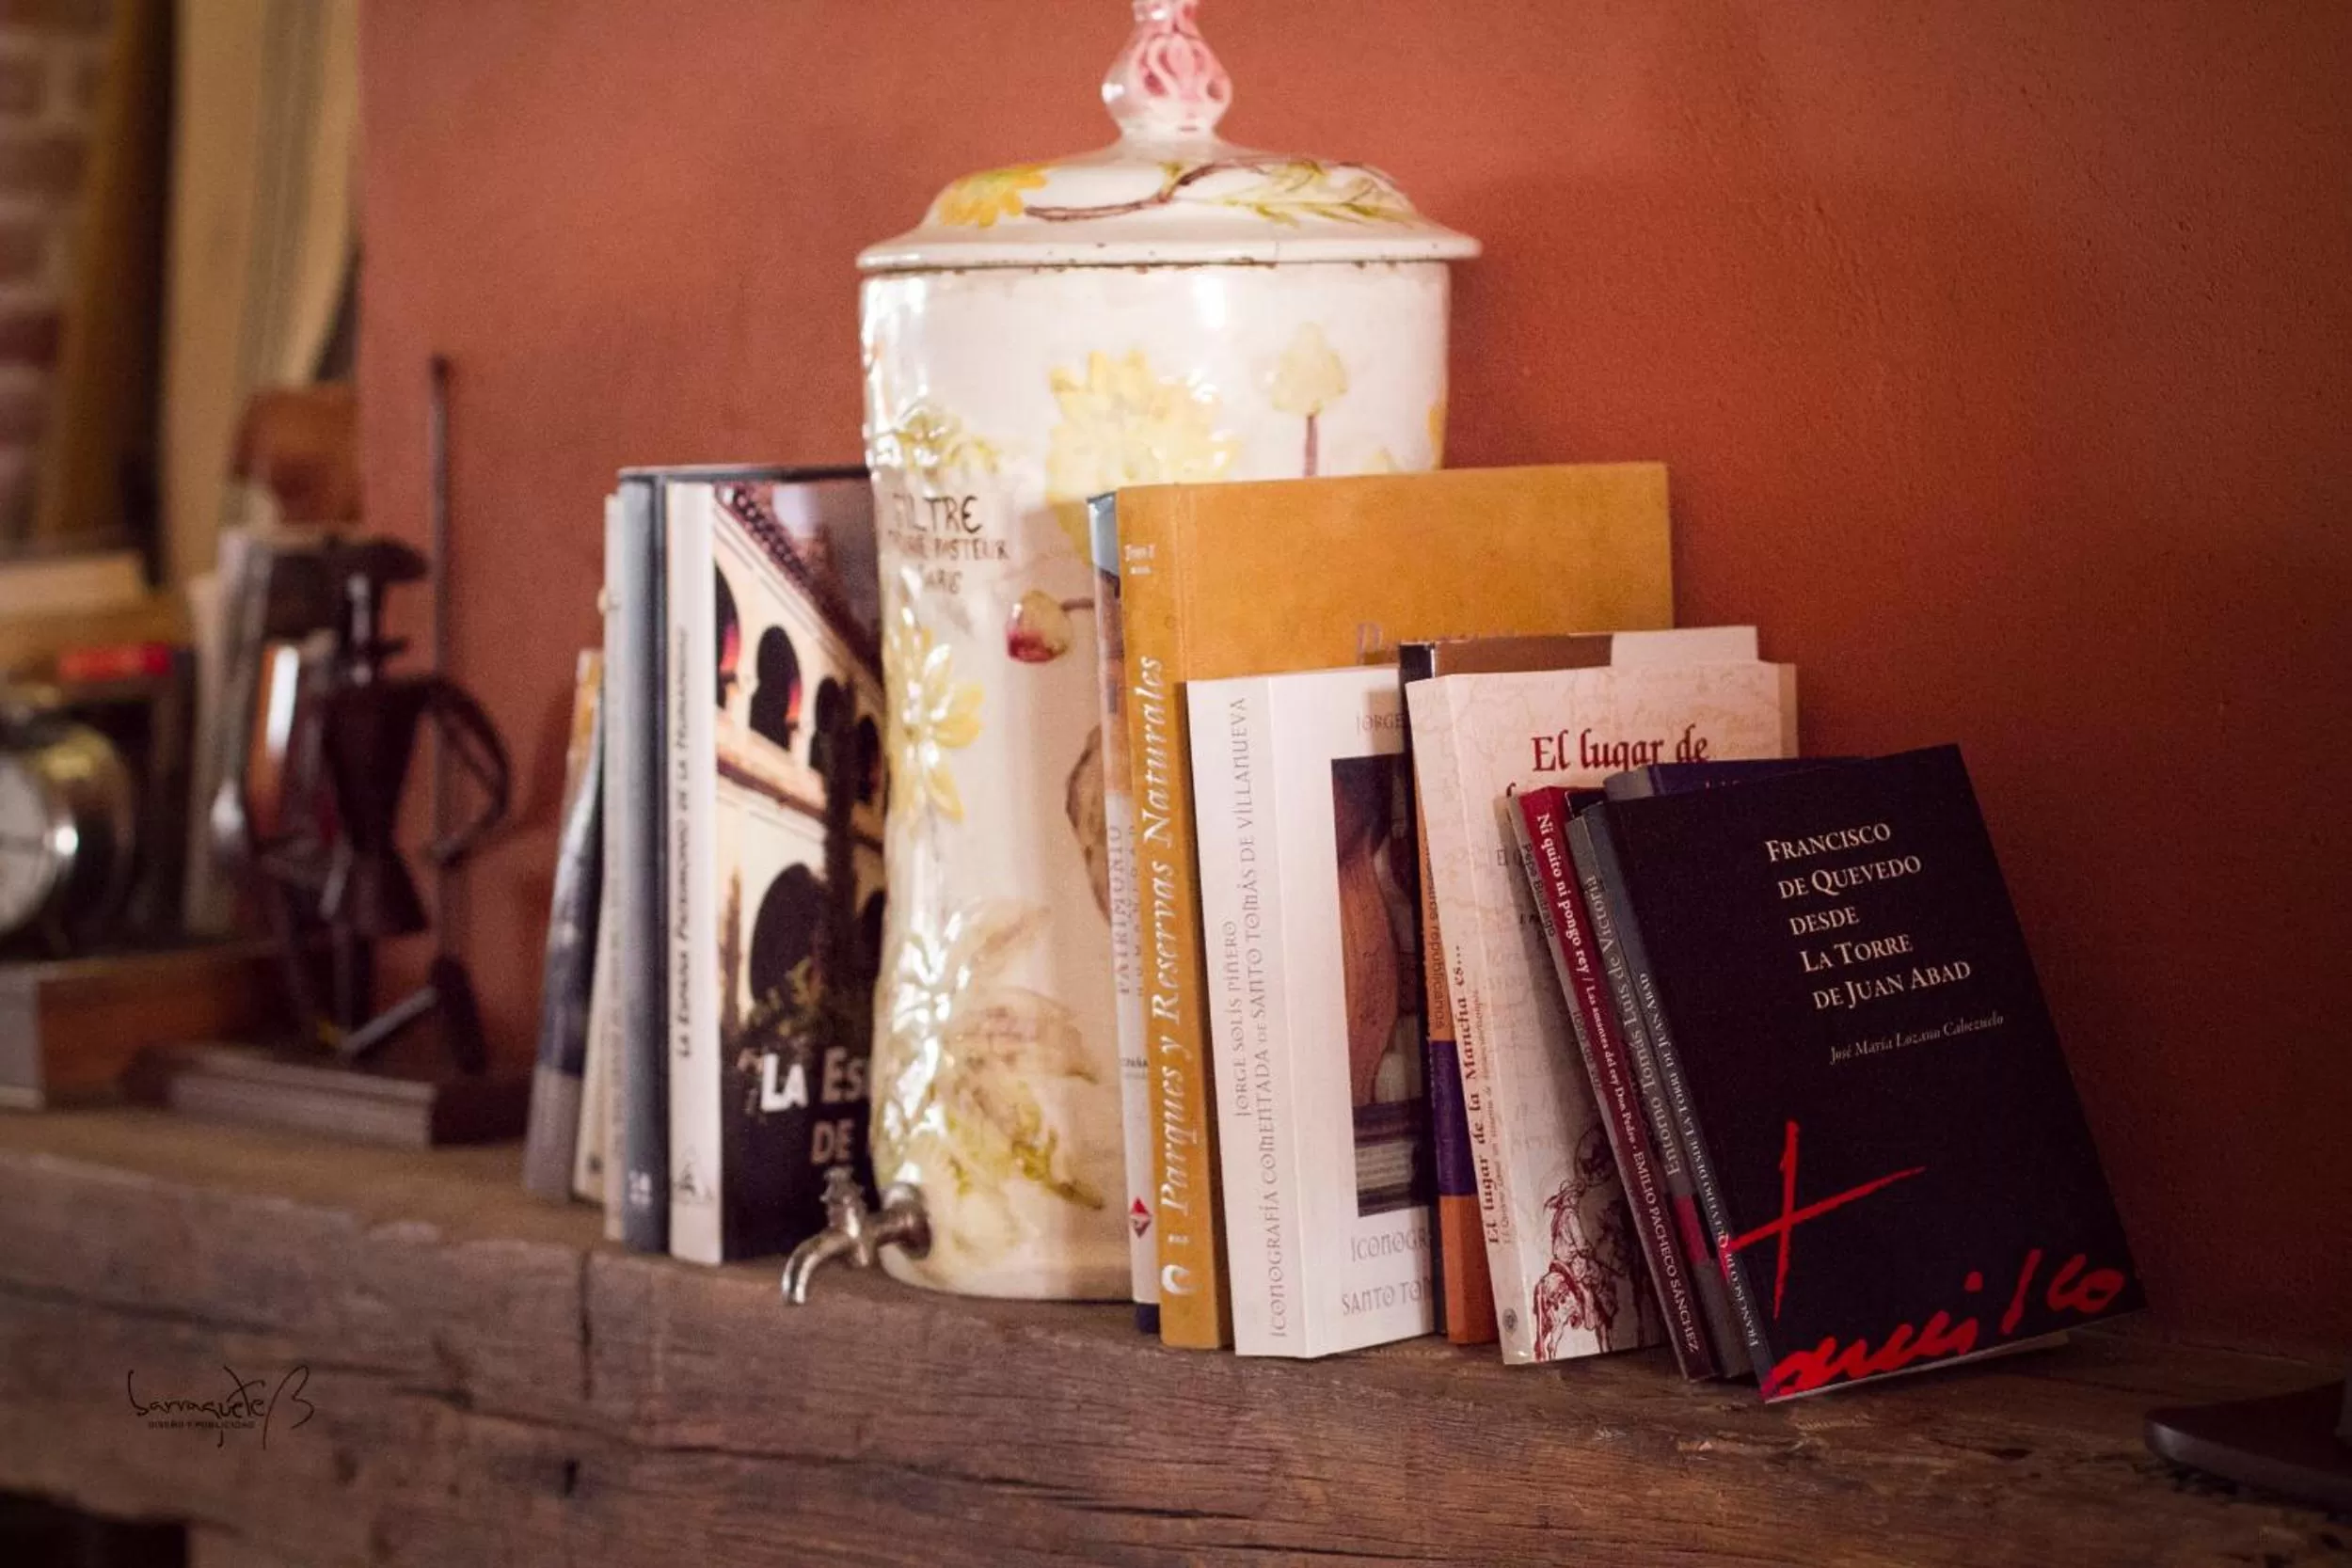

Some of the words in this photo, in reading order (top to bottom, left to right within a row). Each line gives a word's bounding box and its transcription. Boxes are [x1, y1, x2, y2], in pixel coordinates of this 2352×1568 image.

[1135, 656, 1174, 848] Naturales
[1230, 698, 1254, 829] VILLANUEVA
[1531, 729, 1570, 772] El
[1676, 723, 1709, 764] de
[1537, 813, 1553, 835] Ni
[1766, 823, 1891, 863] FRANCISCO
[1541, 837, 1564, 878] quito
[1778, 878, 1809, 899] DE
[1812, 855, 1922, 895] QUEVEDO
[1556, 879, 1571, 899] ni
[1558, 900, 1582, 947] pongo
[1584, 876, 1614, 953] Victoria
[1789, 906, 1860, 936] DESDE
[1151, 860, 1182, 1025] Reservas
[1572, 948, 1590, 974] rey
[1607, 956, 1624, 978] de
[1800, 950, 1834, 973] LA
[1834, 934, 1914, 965] TORRE
[1247, 947, 1267, 1018] SANTO
[1617, 983, 1638, 1027] Luis
[1640, 973, 1658, 1011] ABAD
[1813, 987, 1844, 1009] DE
[1845, 974, 1905, 1008] JUAN
[1911, 960, 1972, 990] ABAD
[1160, 1036, 1194, 1059] y
[1455, 996, 1478, 1080] Mancha
[1629, 1031, 1655, 1093] Tomás
[1830, 1046, 1851, 1065] José
[1854, 1039, 1893, 1057] María
[1896, 1029, 1941, 1048] Lozano
[760, 1053, 809, 1113] LA
[1234, 1055, 1251, 1116] JORGE
[1469, 1093, 1481, 1111] la
[1160, 1065, 1198, 1216] Parques
[1256, 1048, 1279, 1184] COMENTADA
[1472, 1122, 1486, 1145] de
[1652, 1098, 1680, 1176] Entorno
[811, 1117, 855, 1165] DE
[1479, 1155, 1497, 1211] lugar
[1633, 1152, 1656, 1204] EMILIO
[1263, 1191, 1287, 1337] ICONOGRAFÍA
[1649, 1208, 1677, 1276] PACHECO
[1342, 1284, 1395, 1317] SANTO
[1670, 1277, 1699, 1352] SÁNCHEZ
